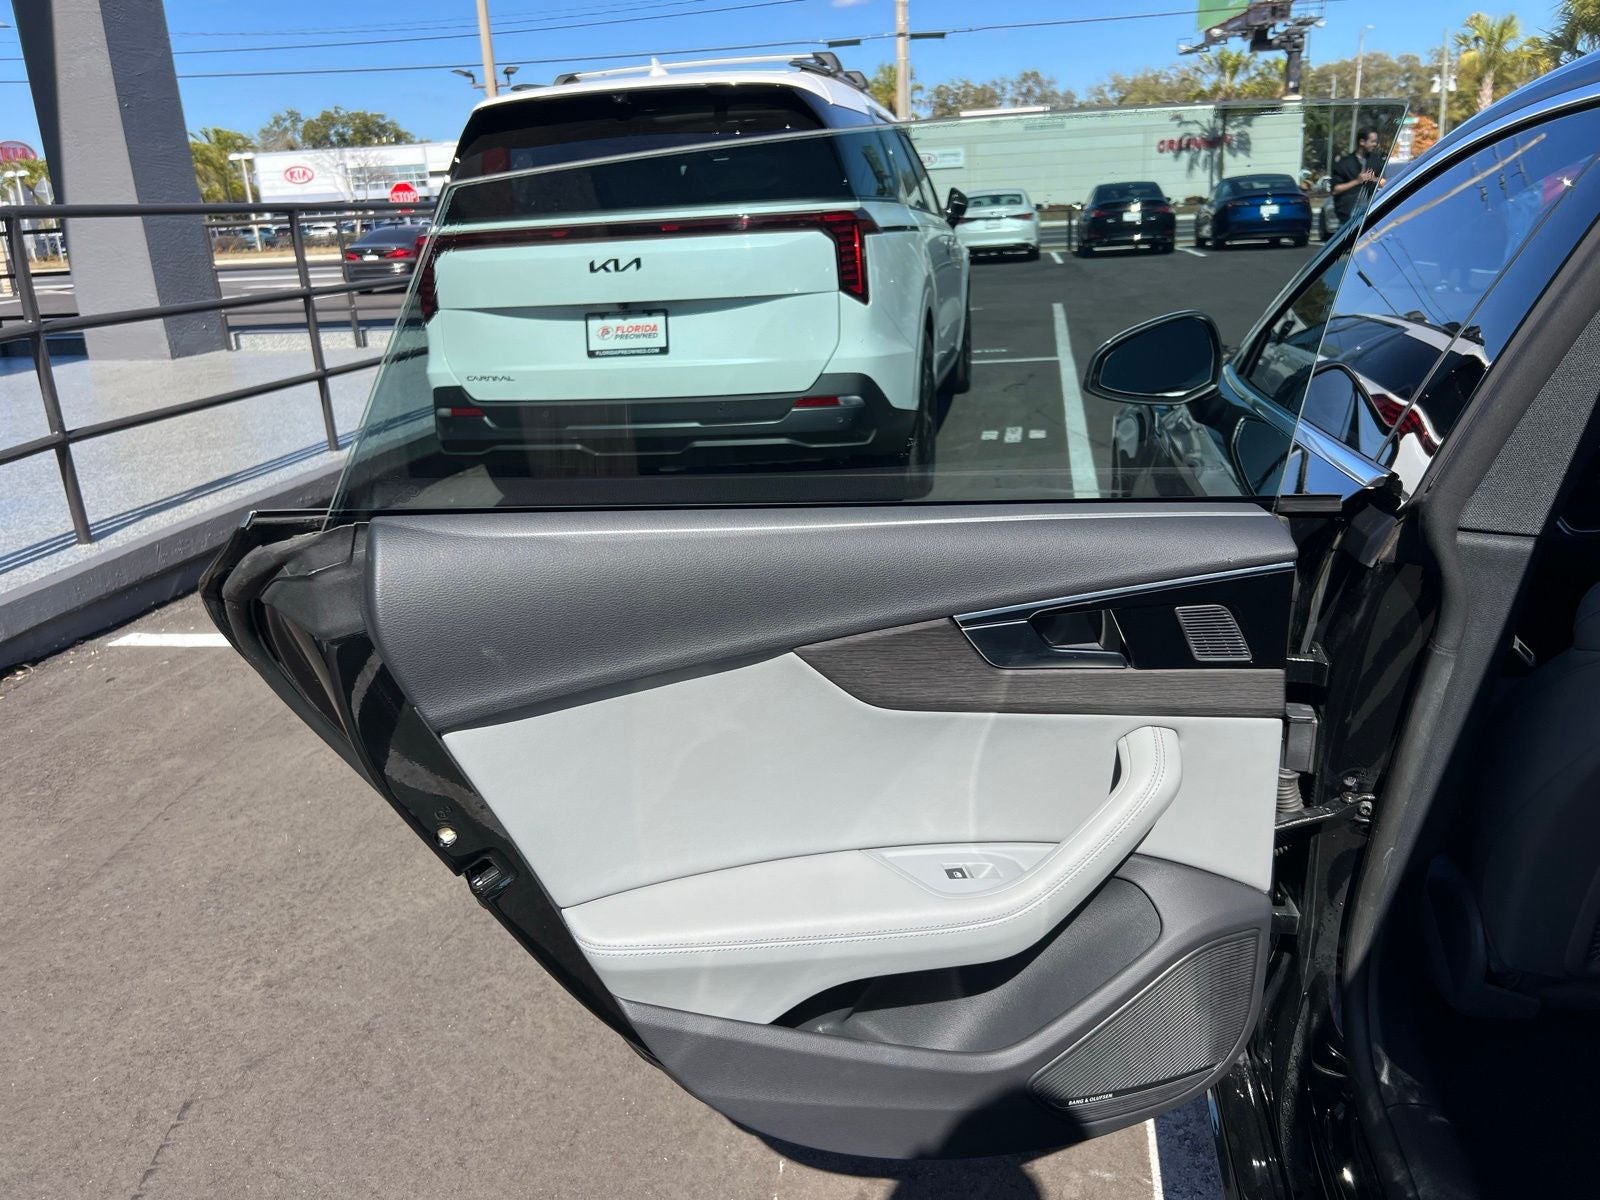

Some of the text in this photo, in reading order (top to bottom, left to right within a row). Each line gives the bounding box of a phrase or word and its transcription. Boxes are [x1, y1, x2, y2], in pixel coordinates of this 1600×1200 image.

[289, 169, 311, 180] KIA
[390, 191, 418, 202] STOP
[589, 257, 642, 273] KIA
[615, 324, 658, 334] FLORIDA
[614, 332, 659, 340] PREOWNED
[1068, 1098, 1084, 1106] BANG
[1090, 1092, 1113, 1102] OLUFSEN
